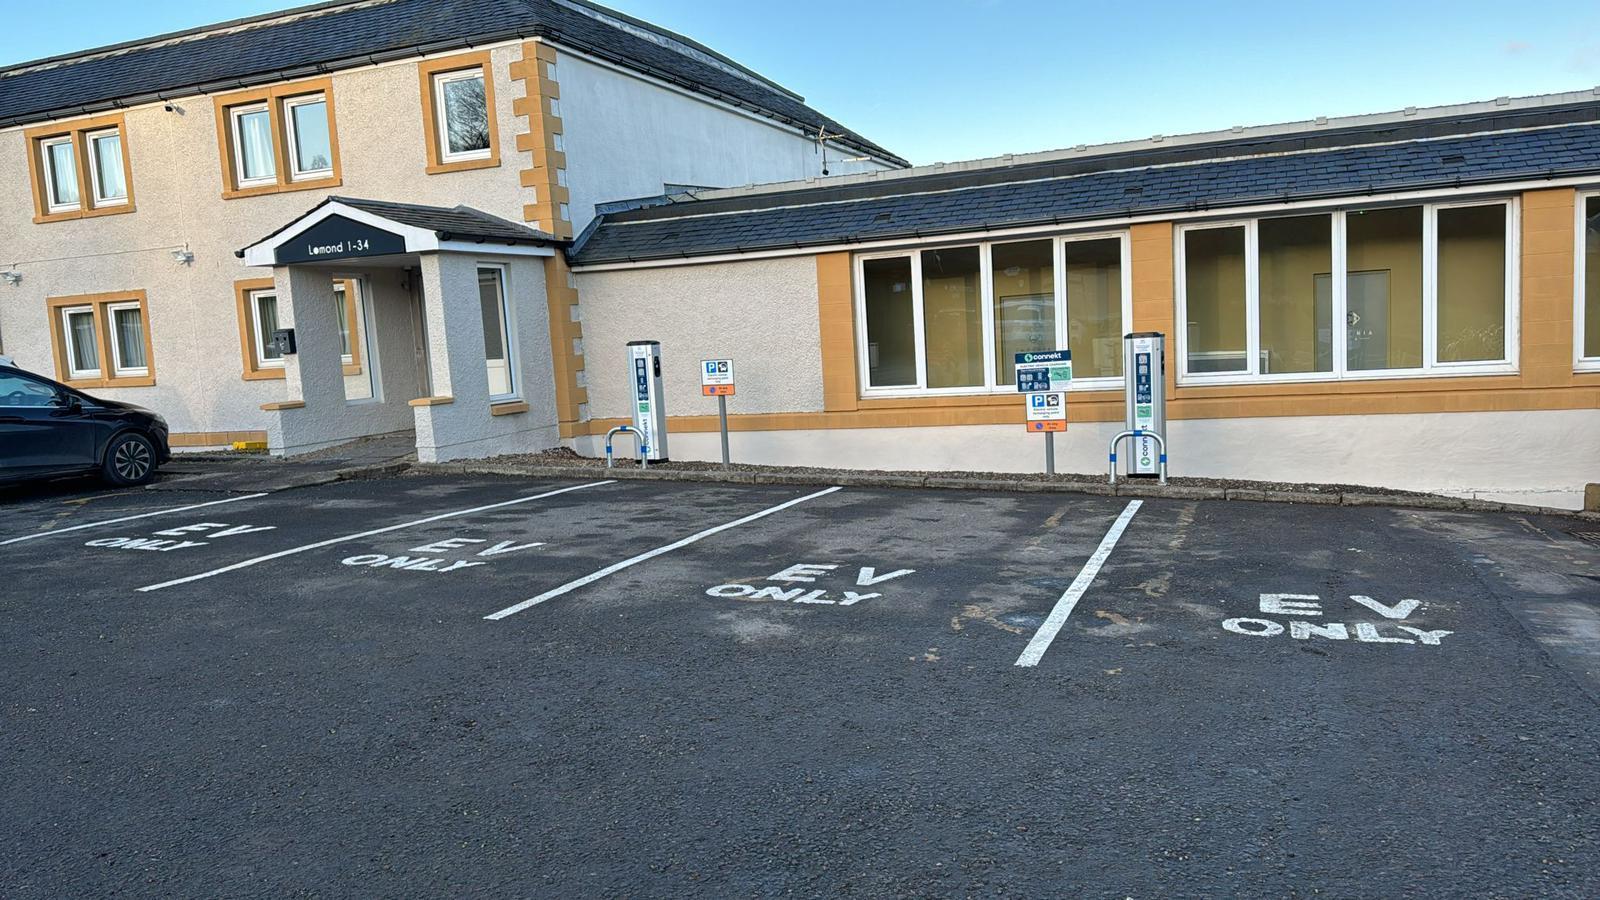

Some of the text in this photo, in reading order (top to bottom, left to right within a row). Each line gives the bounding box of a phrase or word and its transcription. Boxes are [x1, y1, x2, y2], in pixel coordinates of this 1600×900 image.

[308, 239, 369, 255] Lomond 1-34
[1033, 352, 1062, 360] connekt
[1034, 395, 1044, 407] P
[341, 554, 486, 572] ONLY
[705, 584, 882, 606] ONLY
[1259, 593, 1422, 619] EV
[1222, 617, 1454, 645] ONLY
